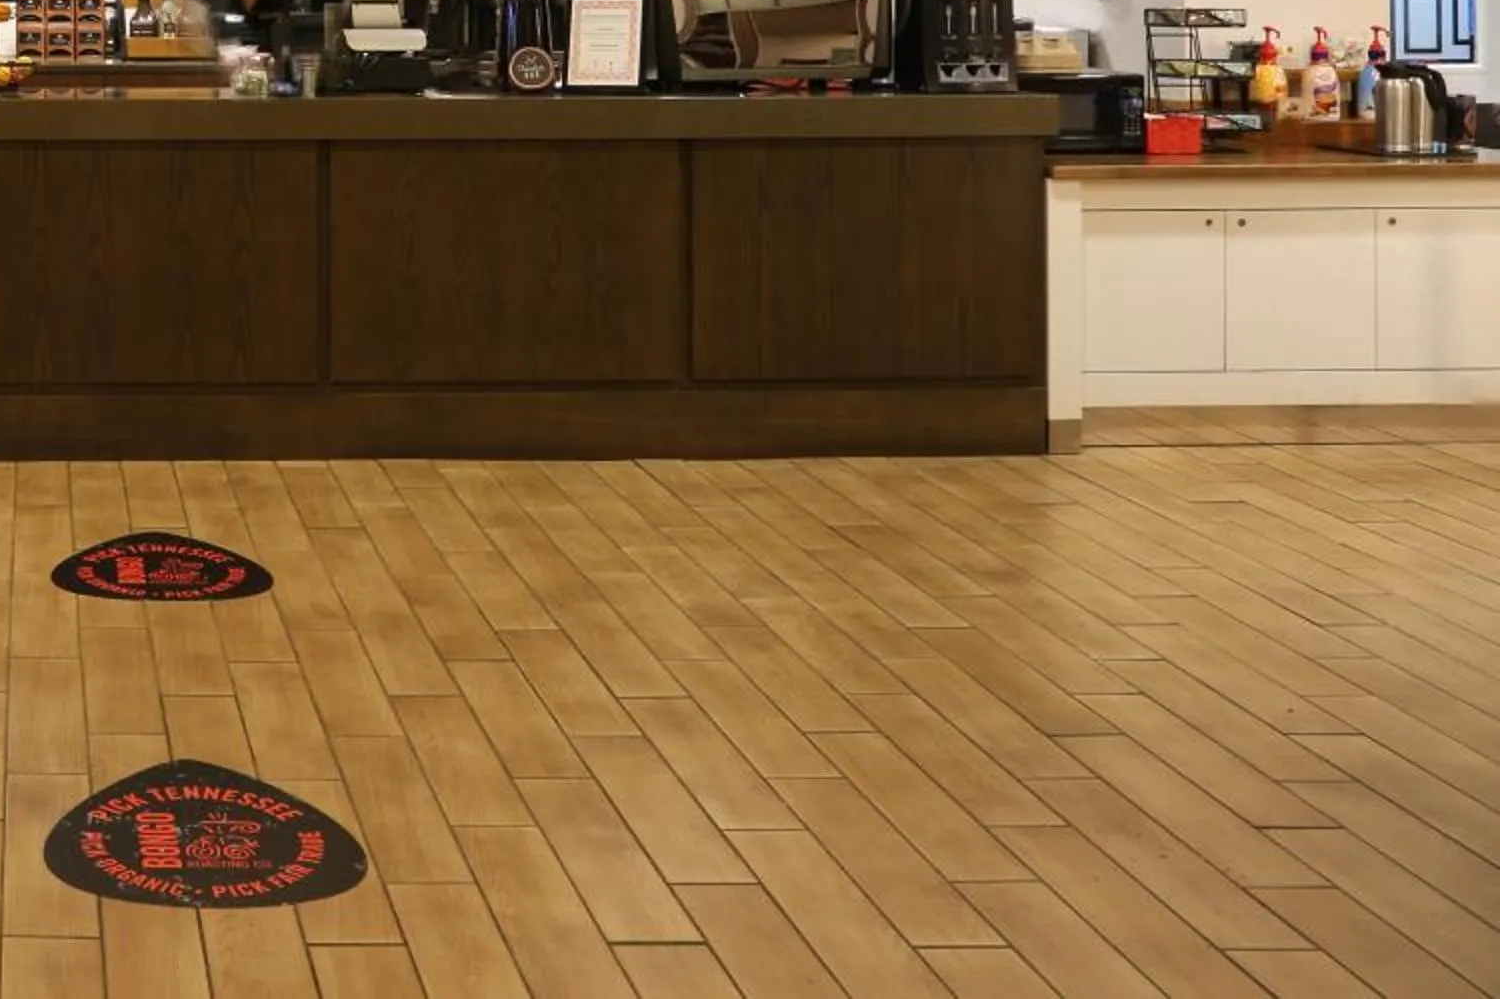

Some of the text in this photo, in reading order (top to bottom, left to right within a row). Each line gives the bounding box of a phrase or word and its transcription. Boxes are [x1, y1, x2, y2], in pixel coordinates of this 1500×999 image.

[87, 785, 304, 824] PICK TENNESSEE
[135, 812, 183, 869] BONGO
[95, 858, 189, 897] ORGANIC
[211, 880, 271, 898] PICK
[266, 863, 317, 888] FAIR
